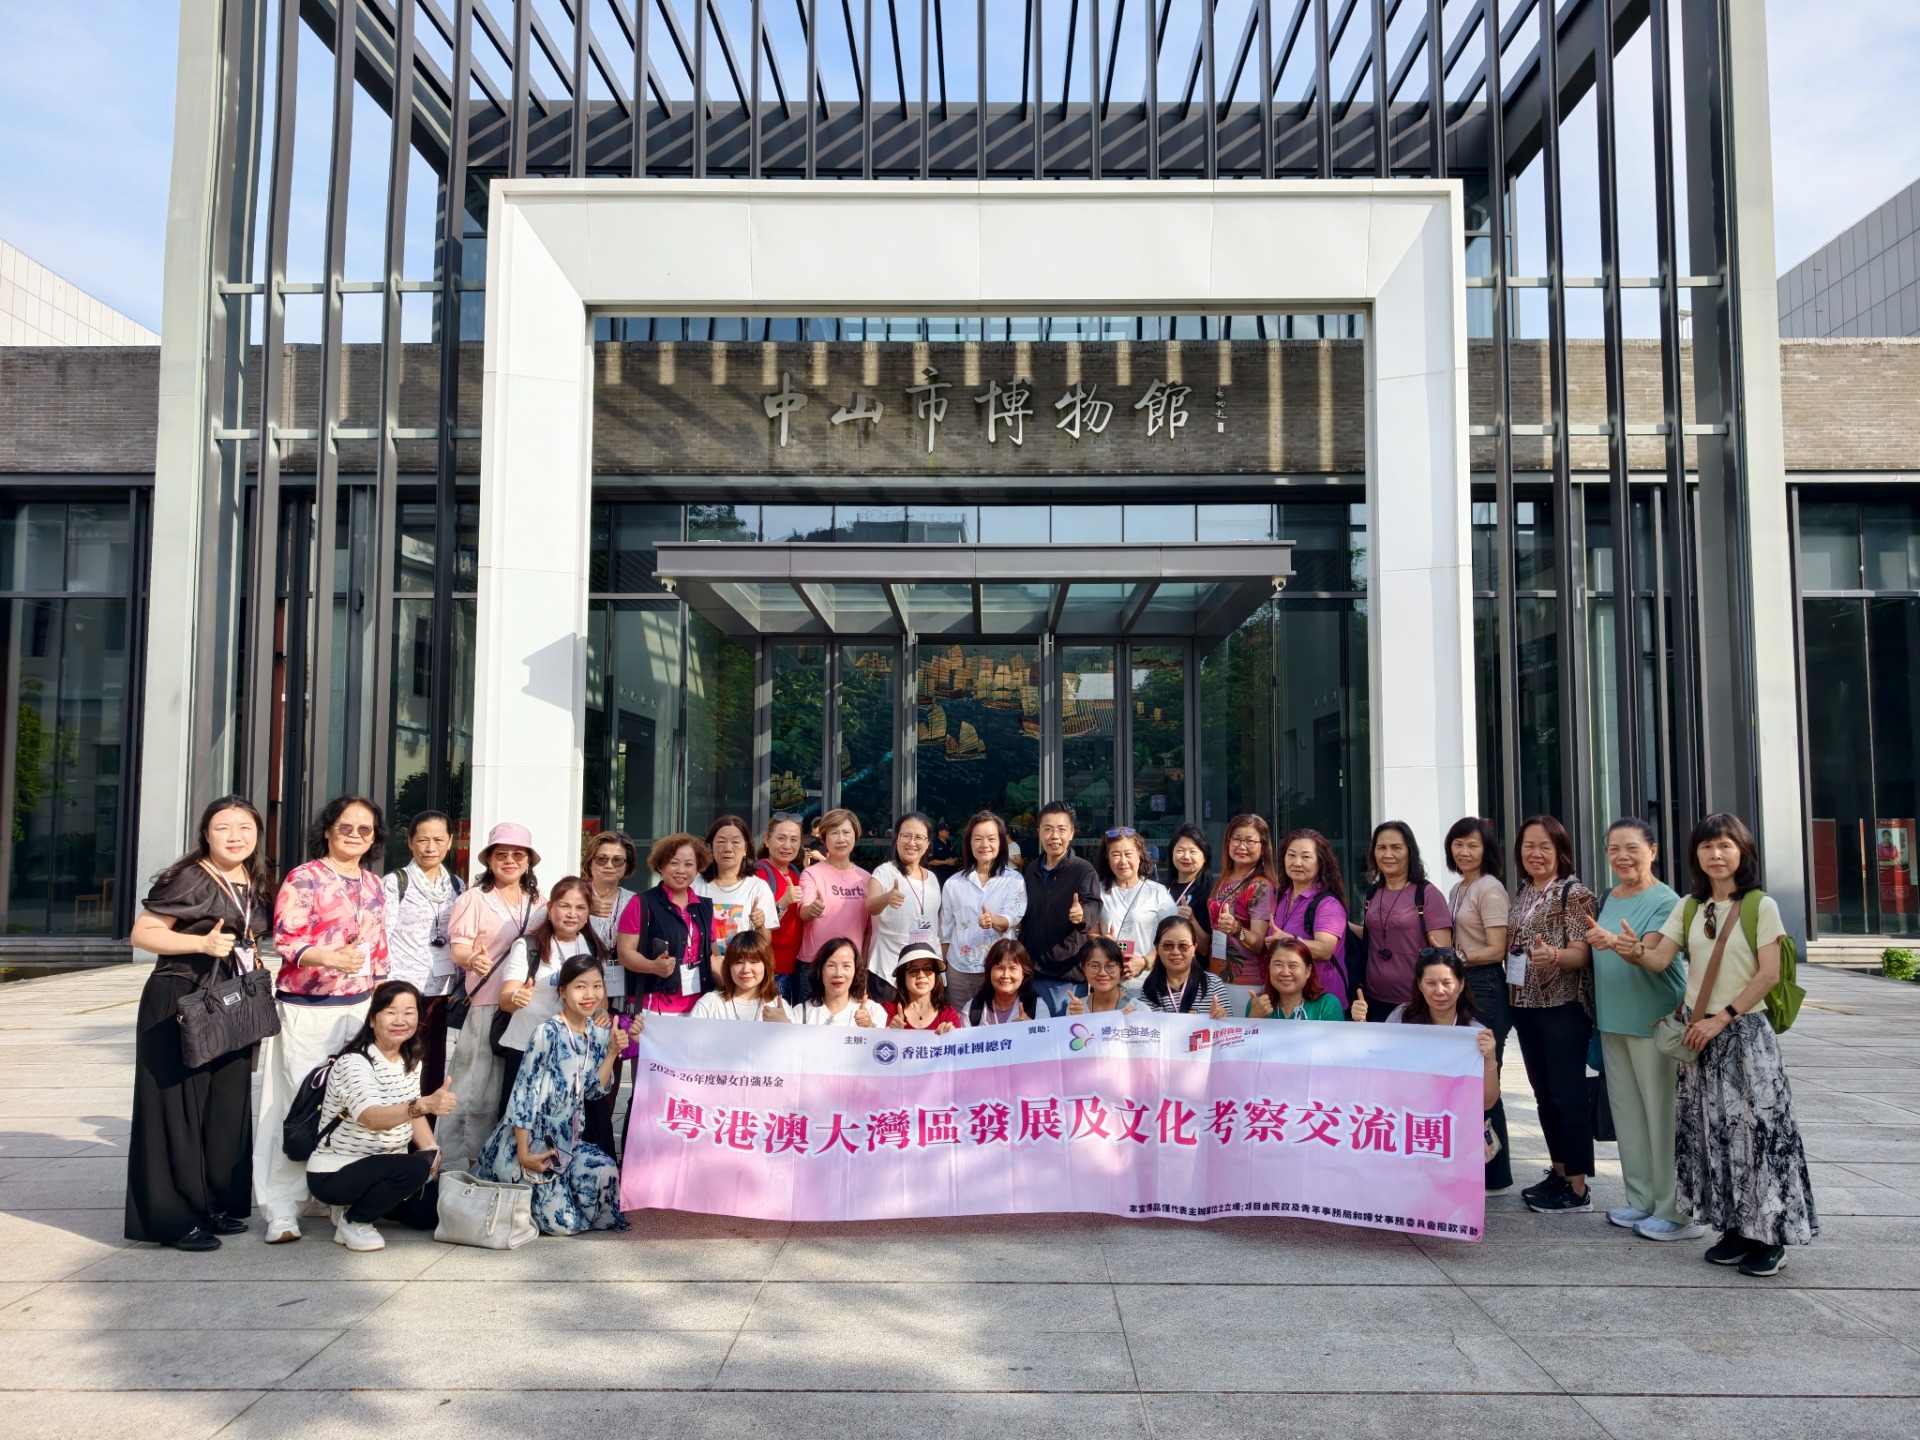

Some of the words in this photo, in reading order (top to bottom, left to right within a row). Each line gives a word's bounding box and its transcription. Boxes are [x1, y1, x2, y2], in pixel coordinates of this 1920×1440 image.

[763, 366, 1193, 454] 中山市博物館
[1101, 1025, 1161, 1039] 婦女自強基金
[901, 1038, 1013, 1060] 香港深圳社團總會
[649, 1062, 784, 1088] 2025-26年度婦女自強基金
[660, 1096, 1452, 1159] 粵港澳大灣區發展及文化考察交流團
